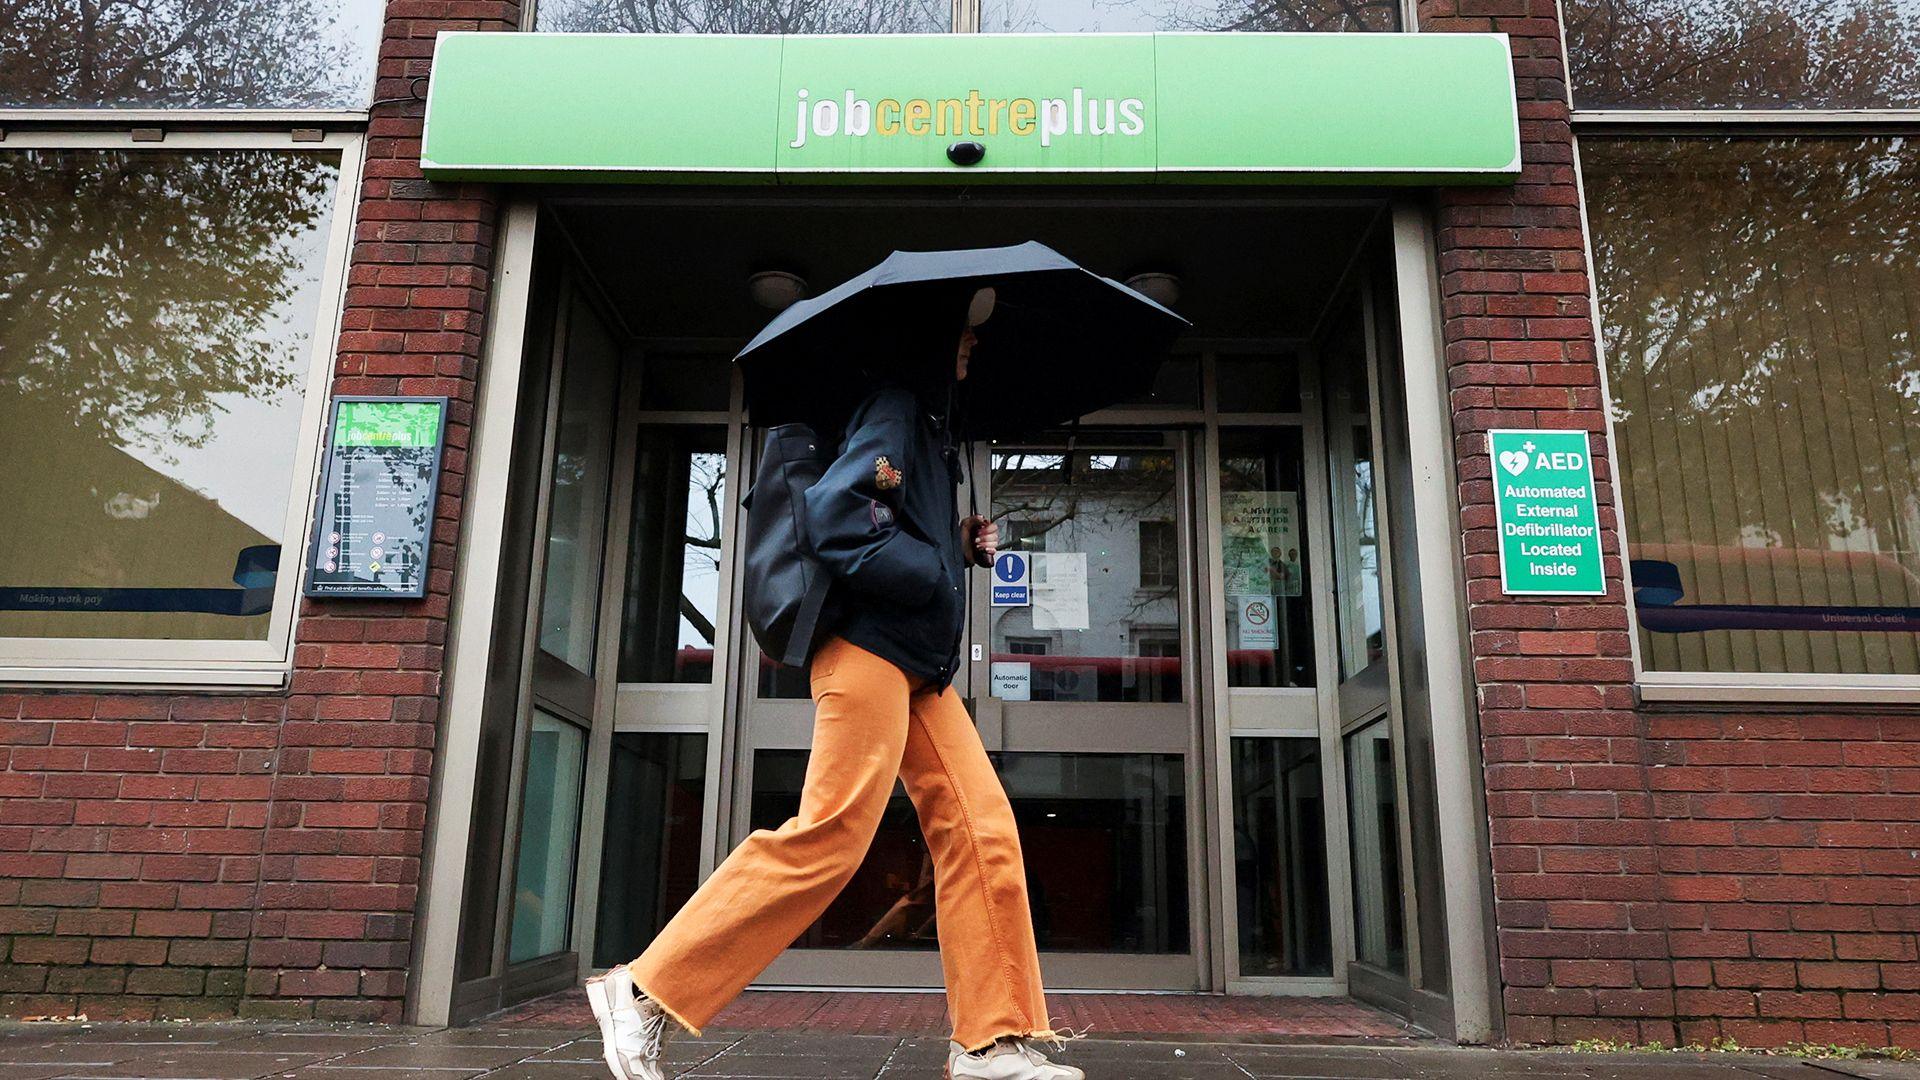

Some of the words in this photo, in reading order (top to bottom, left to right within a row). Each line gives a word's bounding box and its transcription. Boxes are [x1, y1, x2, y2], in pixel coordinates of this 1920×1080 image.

[789, 87, 1145, 149] jobcentreplus
[347, 430, 412, 442] jobcentreplus
[1534, 452, 1584, 470] AED
[1504, 484, 1586, 499] Automated
[1516, 503, 1578, 517] External
[1505, 522, 1594, 537] Defibrillator
[1520, 542, 1582, 556] Located
[1530, 562, 1577, 576] Inside
[19, 594, 55, 606] Making
[57, 594, 82, 604] work
[84, 595, 103, 606] pay
[994, 591, 1010, 600] Keep
[1011, 591, 1026, 599] clear
[1822, 613, 1872, 624] Universal
[1873, 613, 1907, 624] Credit
[994, 674, 1028, 682] Automatic
